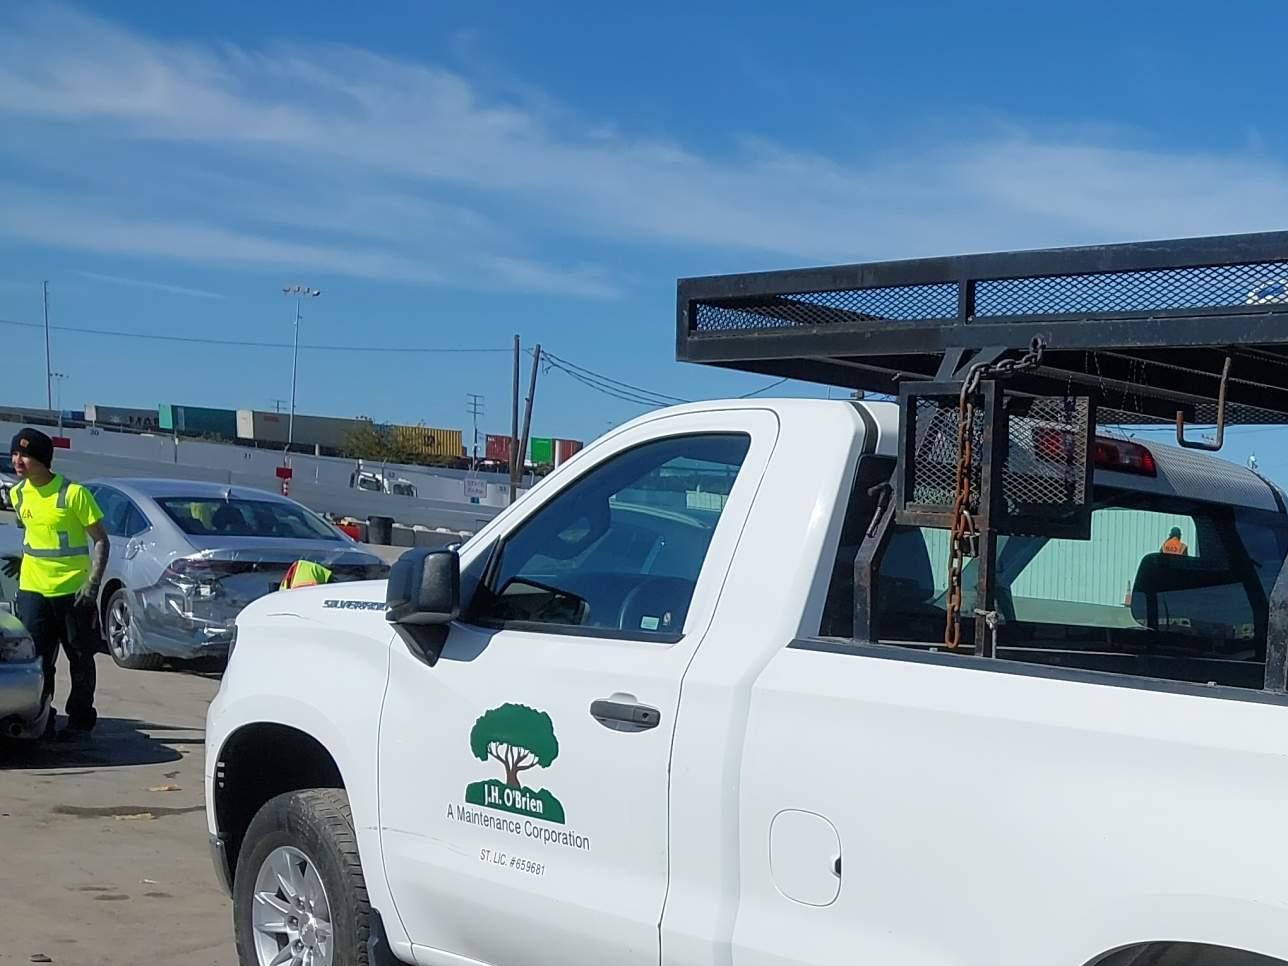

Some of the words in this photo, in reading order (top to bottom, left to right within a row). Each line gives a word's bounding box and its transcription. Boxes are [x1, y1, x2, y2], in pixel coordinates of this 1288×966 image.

[485, 784, 502, 806] J.H.
[504, 788, 543, 814] O'Brien
[447, 804, 454, 819] A
[457, 806, 521, 835] Maintenance
[524, 820, 590, 850] Corporation
[480, 849, 492, 863] ST.
[493, 852, 507, 867] LIC.
